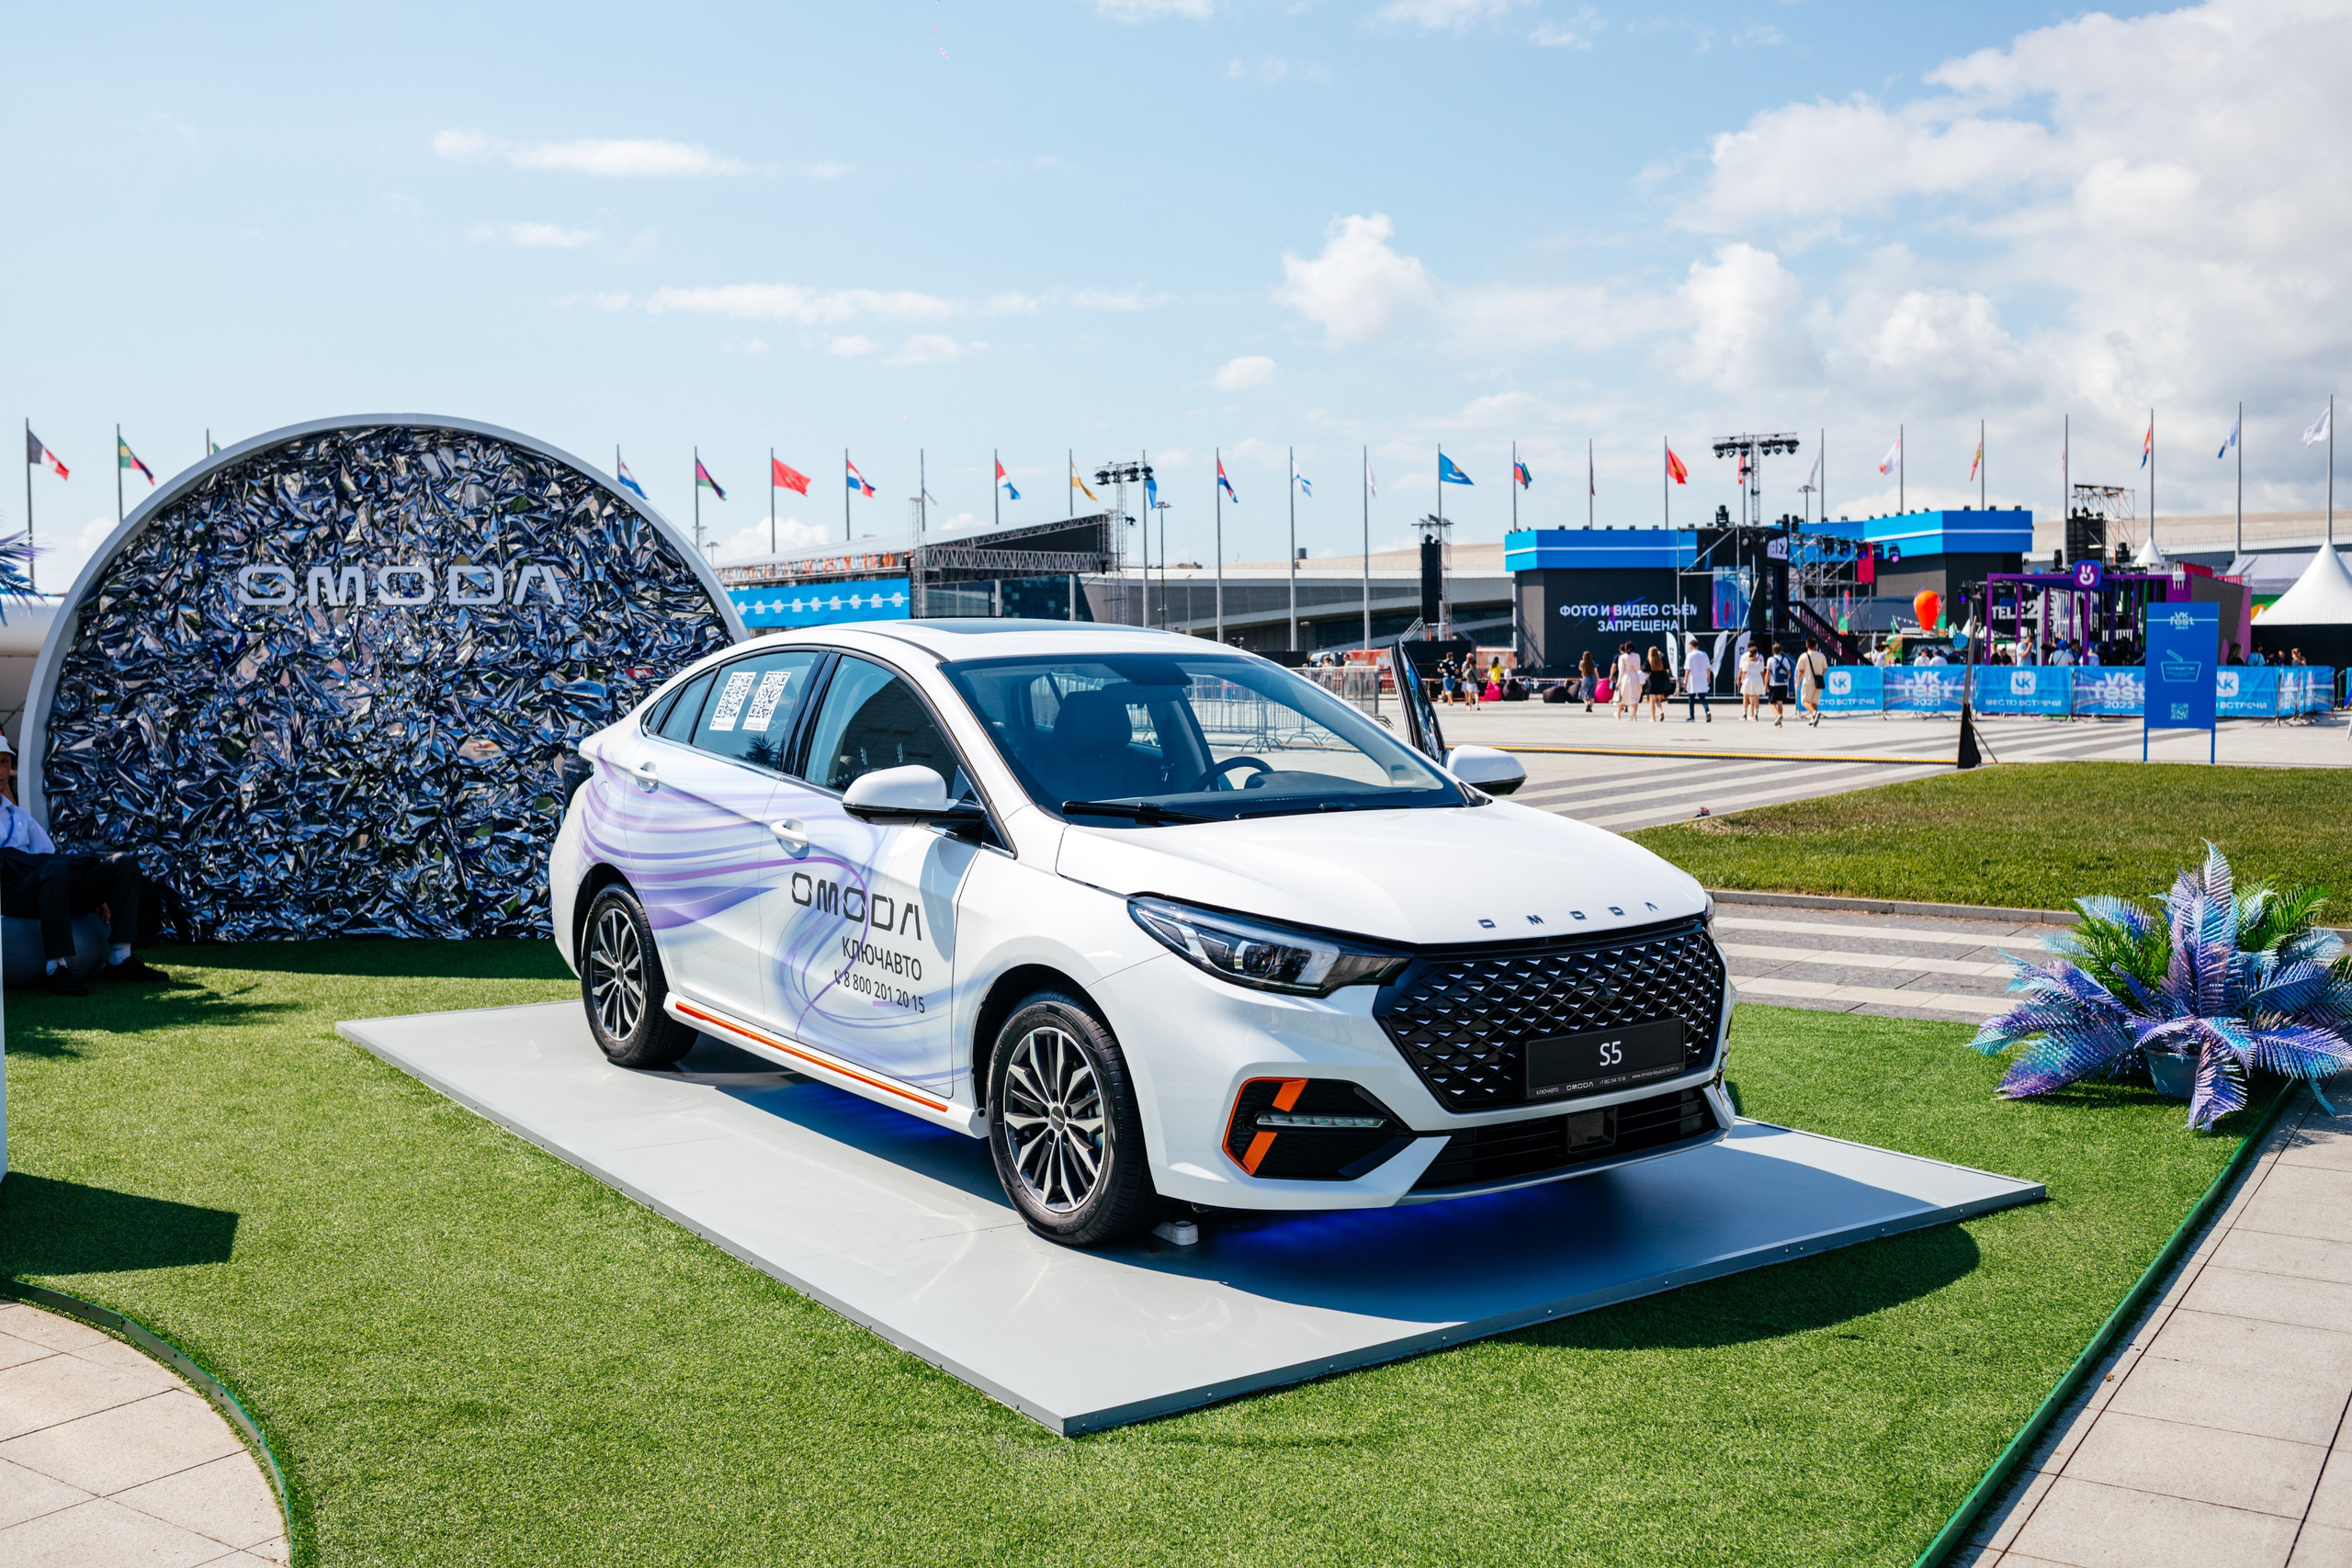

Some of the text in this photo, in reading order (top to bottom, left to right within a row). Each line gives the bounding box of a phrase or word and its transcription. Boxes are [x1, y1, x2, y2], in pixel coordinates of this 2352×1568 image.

[238, 566, 565, 605] OMODA
[1560, 604, 1598, 617] ФОТО
[1600, 605, 1610, 616] И
[1613, 604, 1658, 618] ВИДЕО
[1598, 620, 1679, 633] ЗАПРЕЩЕНА
[1913, 671, 1940, 683] VK
[2015, 678, 2030, 688] VK
[2104, 672, 2134, 685] VK
[1905, 679, 1951, 698] fest
[2094, 681, 2144, 700] fest
[1914, 698, 1940, 706] 2023
[2104, 701, 2134, 709] 2023
[2220, 701, 2267, 709] ВСТРЕЧИ
[791, 872, 922, 941] OMODA
[1477, 901, 1659, 929] OMODA
[842, 936, 922, 981] КЛЮЧАВТО
[844, 971, 925, 1013] 8 800 201 20 15
[1600, 1041, 1623, 1066] S5
[1536, 1087, 1559, 1096] КЛЮЧАВТО
[1566, 1081, 1594, 1091] OMODA
